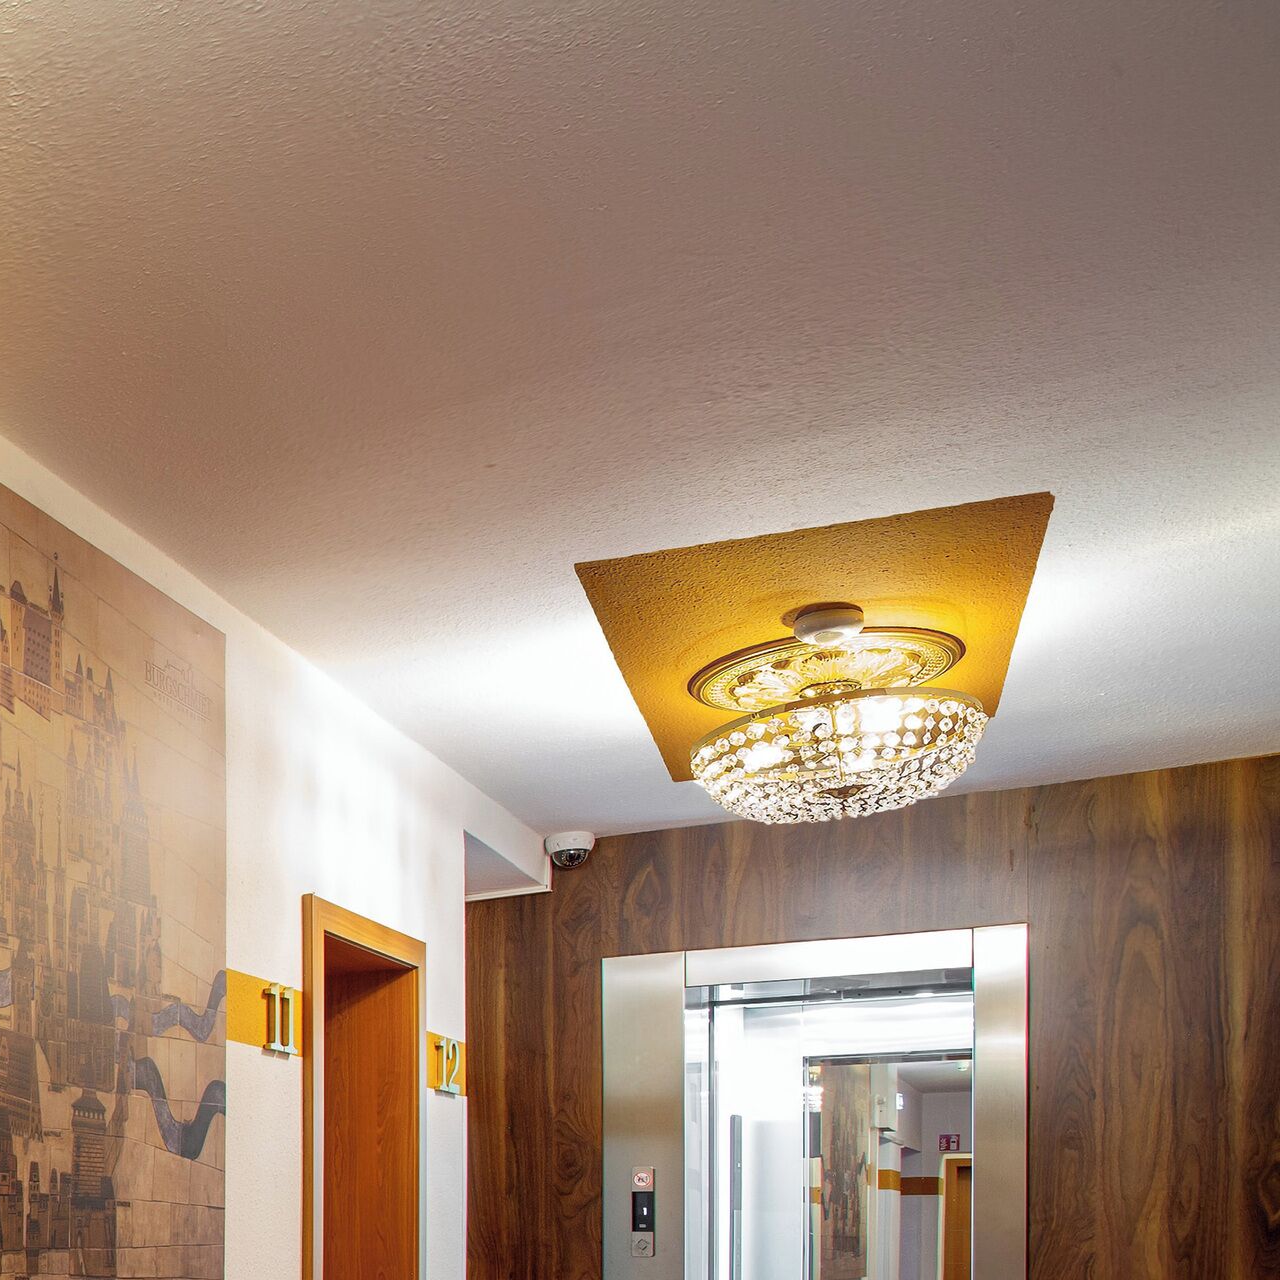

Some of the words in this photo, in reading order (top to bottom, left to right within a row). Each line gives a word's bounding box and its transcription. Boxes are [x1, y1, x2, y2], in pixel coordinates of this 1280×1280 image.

[262, 982, 298, 1054] 11
[434, 1036, 461, 1094] 12
[643, 1207, 648, 1216] 1
